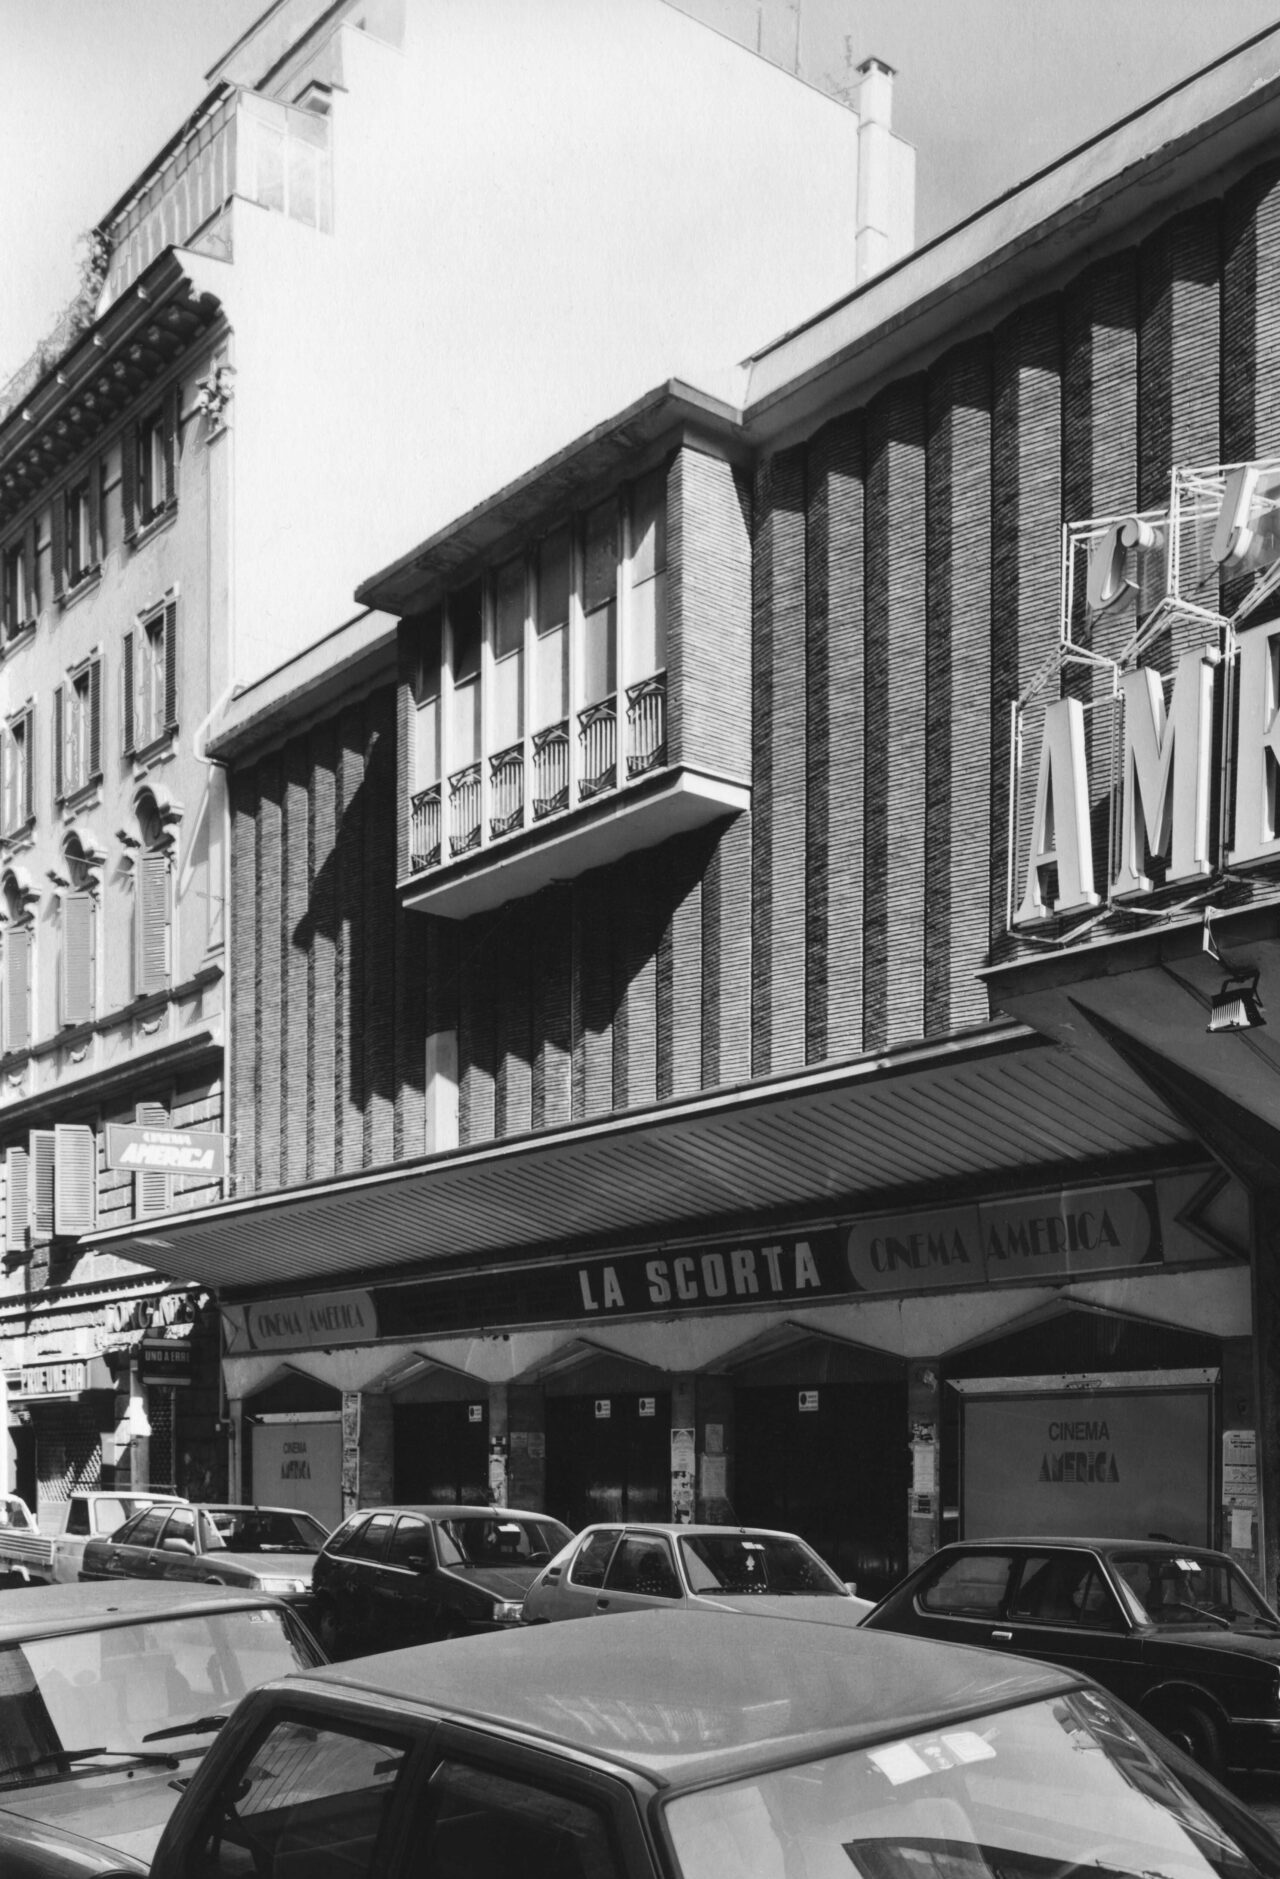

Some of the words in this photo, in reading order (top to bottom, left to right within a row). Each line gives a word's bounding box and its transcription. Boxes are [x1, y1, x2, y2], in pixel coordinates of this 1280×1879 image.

[119, 1142, 215, 1169] AMERICA
[869, 1225, 971, 1273] CINEMA
[985, 1208, 1122, 1261] AMERICA
[578, 1266, 625, 1311] LA
[645, 1241, 822, 1303] SCORTA
[257, 1310, 303, 1338] CINEMA
[309, 1303, 365, 1332] AMERICA
[145, 1350, 163, 1361] UNO
[164, 1351, 170, 1361] A
[1047, 1421, 1111, 1441] CINEMA
[1038, 1451, 1120, 1485] AMERICA
